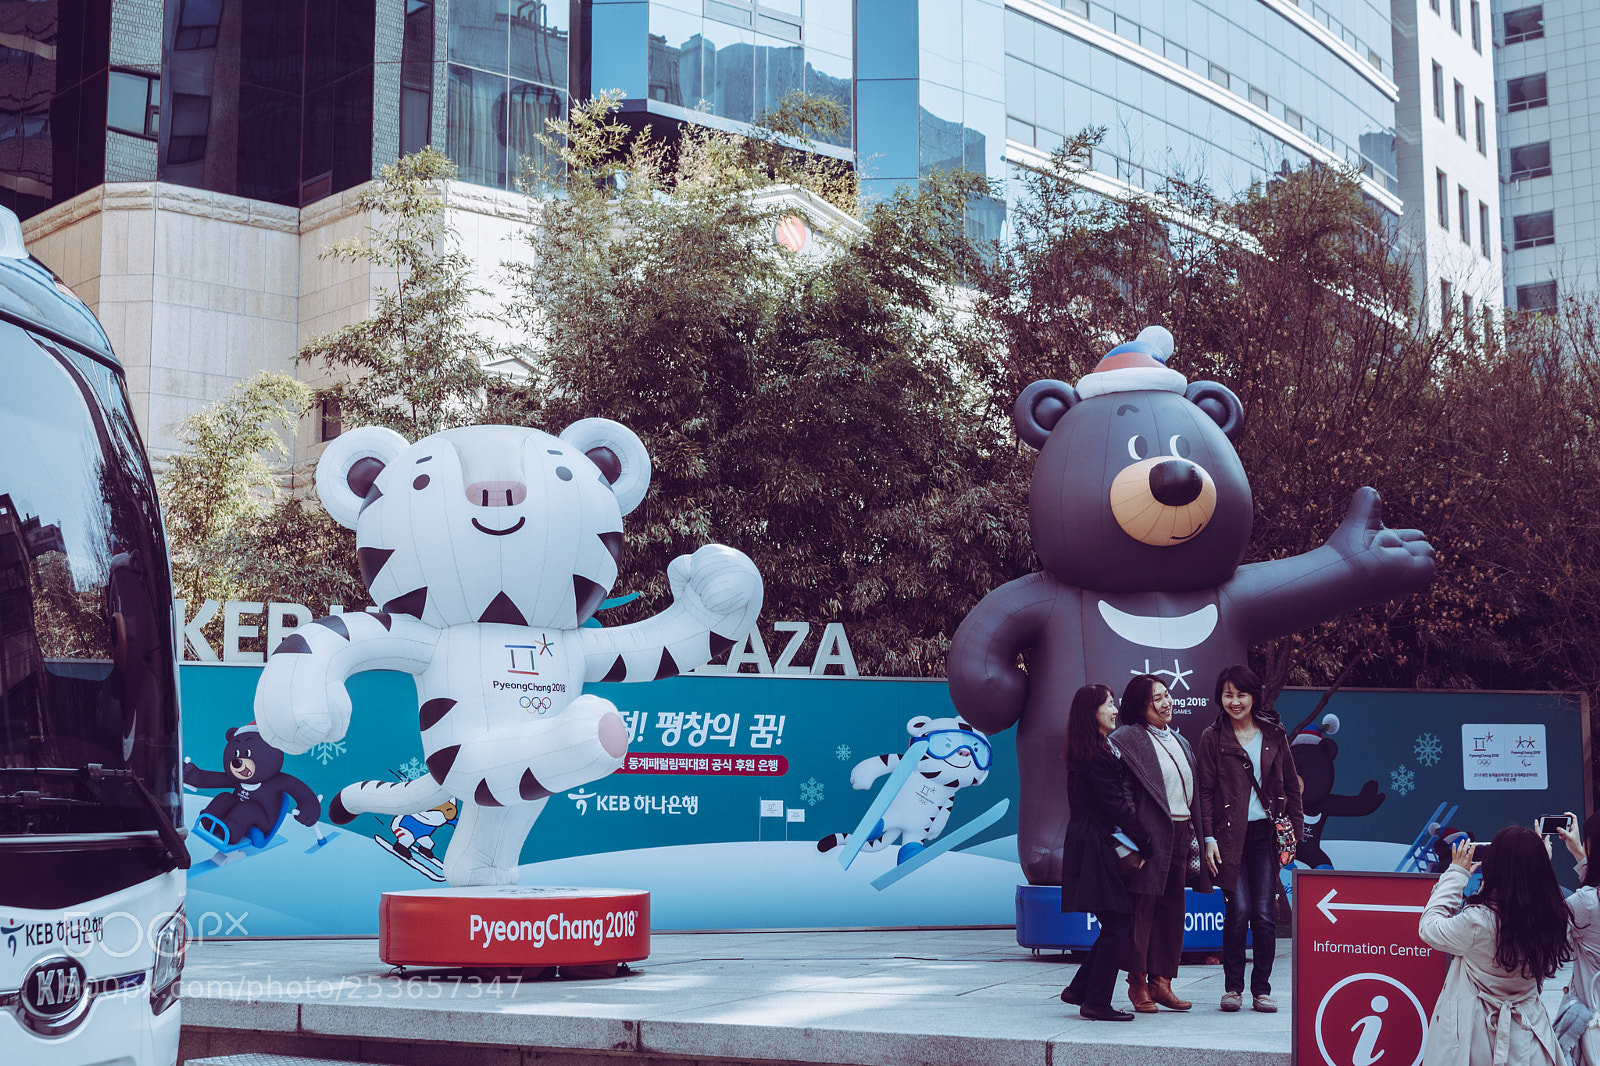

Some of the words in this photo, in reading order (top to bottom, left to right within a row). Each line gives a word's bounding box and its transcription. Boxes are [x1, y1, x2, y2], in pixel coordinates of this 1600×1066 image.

[697, 621, 860, 677] AZA
[493, 680, 551, 693] PyeongChang
[552, 683, 566, 693] 2018
[1186, 697, 1207, 707] 2018
[655, 711, 740, 748] 평창의
[749, 714, 786, 749] 꿈!
[628, 757, 709, 771] 동계패럴림픽대회
[711, 758, 732, 772] 공식
[735, 759, 755, 772] 후원
[757, 759, 778, 772] 은행
[596, 796, 630, 811] KEB
[634, 795, 699, 815] 하나은행
[26, 923, 53, 946] KEB
[57, 917, 103, 945] 하나은행
[470, 913, 603, 948] PyeongChang
[605, 911, 635, 938] 2018
[1313, 940, 1386, 955] Information
[1389, 943, 1432, 957] Center
[36, 967, 81, 1007] KIA
